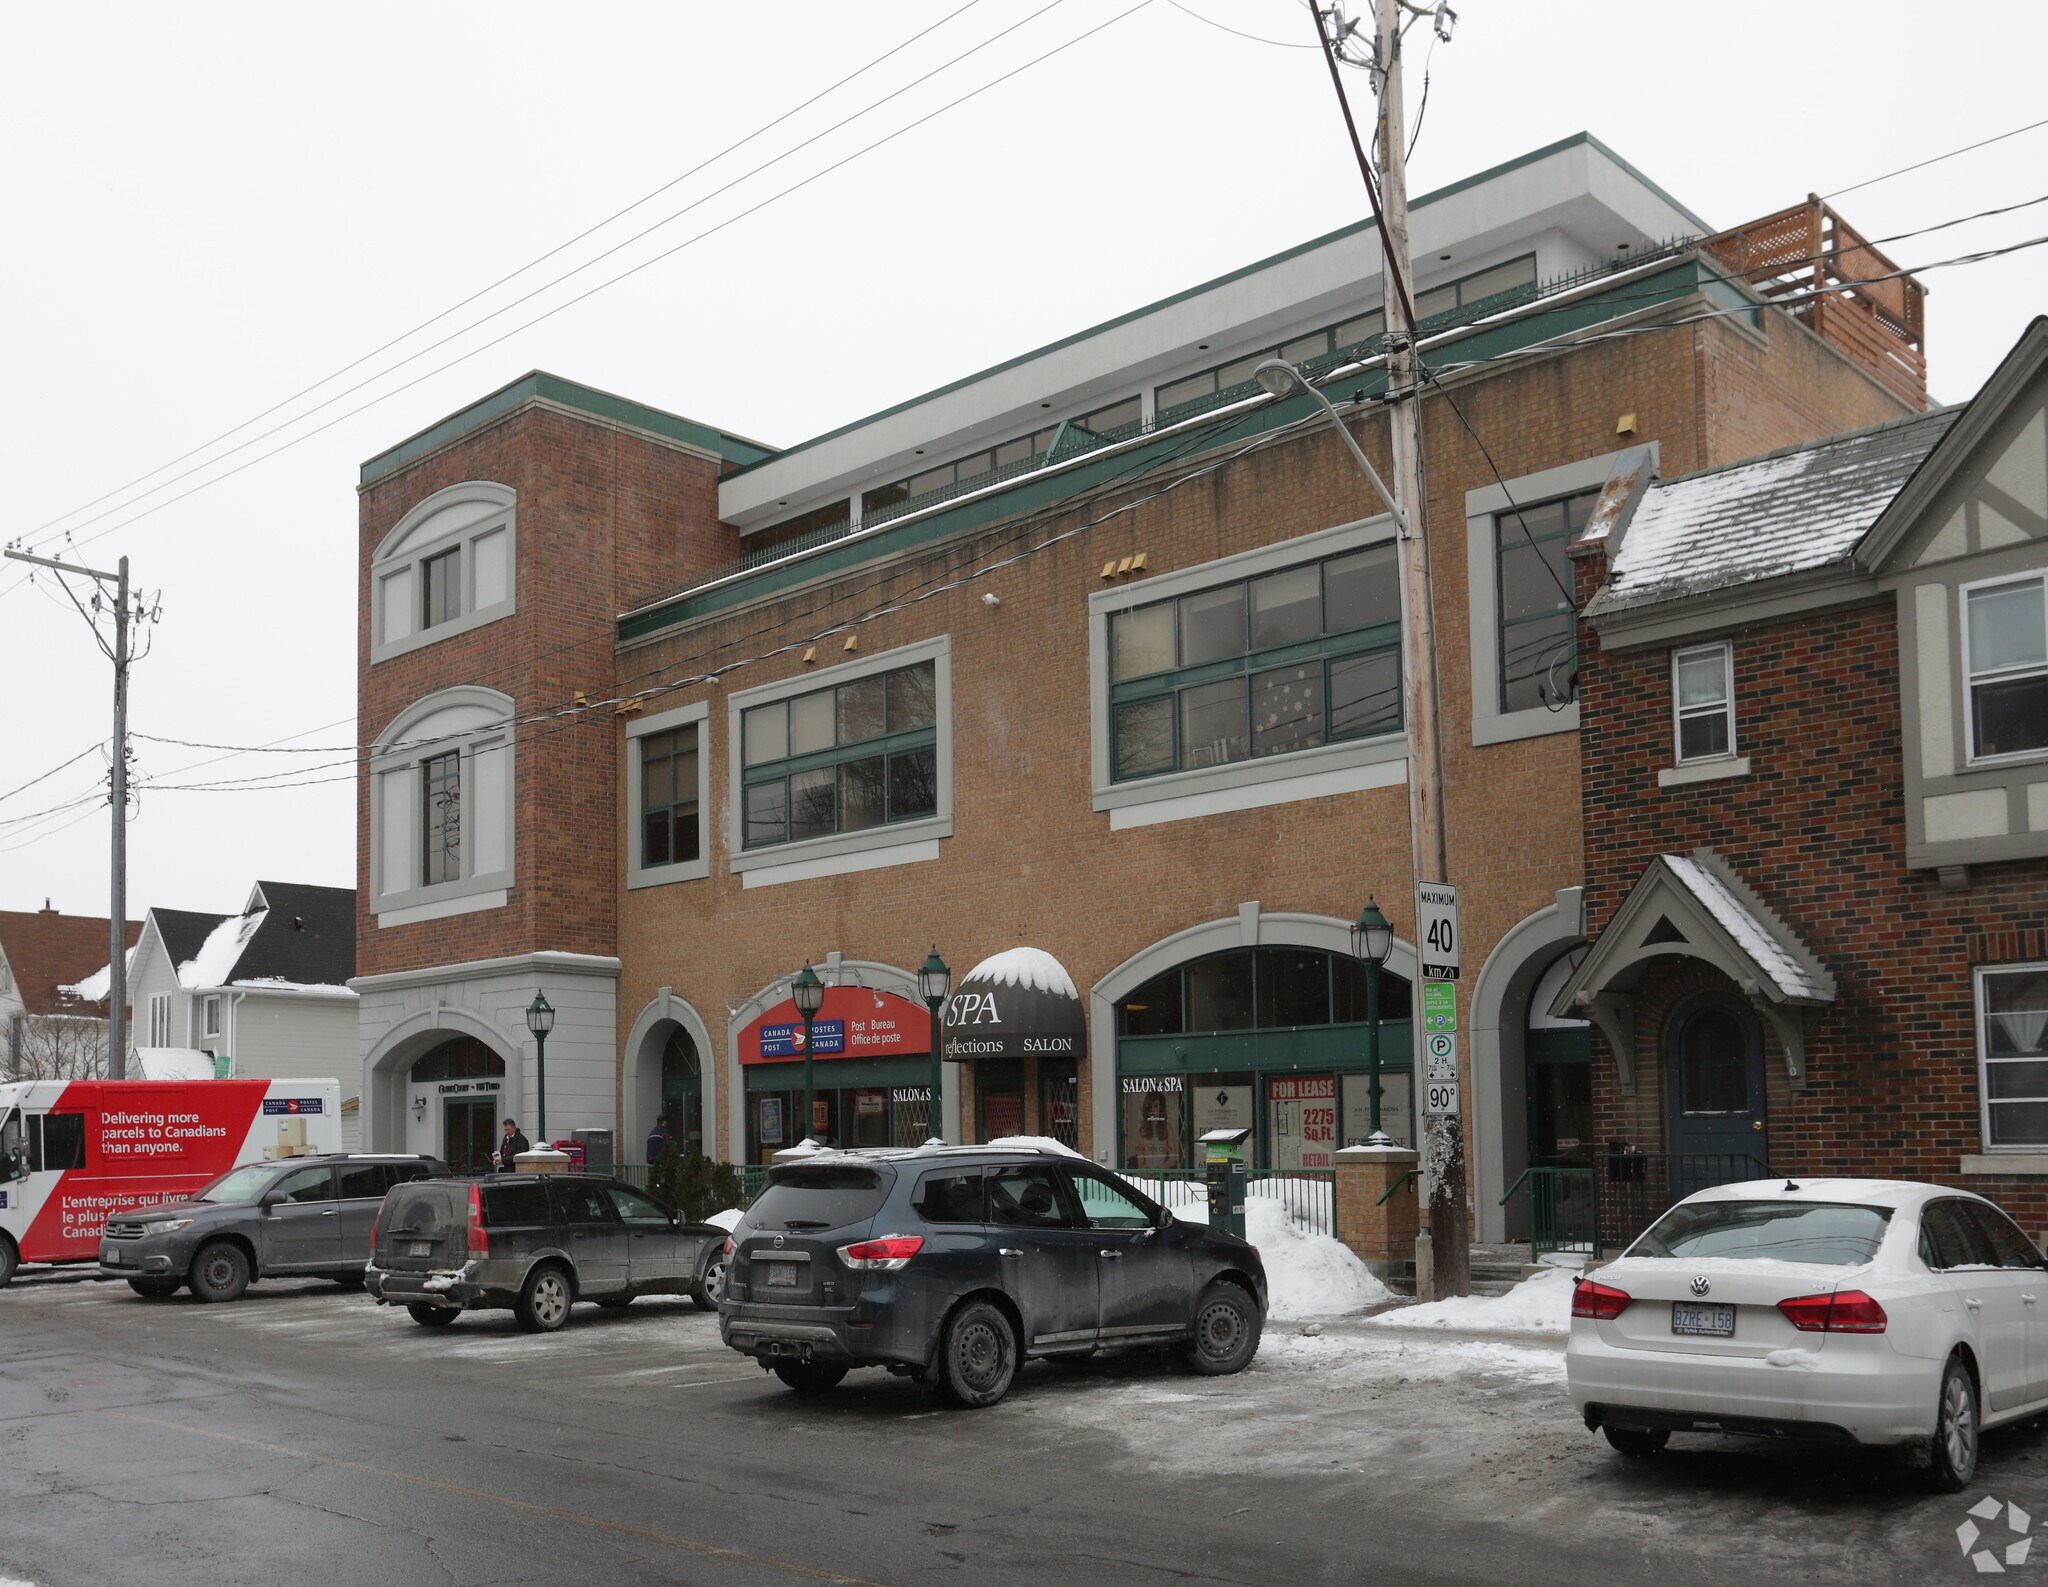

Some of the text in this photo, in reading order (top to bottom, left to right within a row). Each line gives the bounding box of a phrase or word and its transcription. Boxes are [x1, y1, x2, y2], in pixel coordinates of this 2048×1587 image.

[1421, 892, 1454, 906] MAXIMUM
[1427, 919, 1453, 953] 40
[1428, 965, 1454, 979] km/h
[946, 992, 1002, 1027] SPA
[764, 1029, 791, 1037] CANADA
[851, 1020, 896, 1032] Post Bureau
[851, 1032, 901, 1046] Office de poste
[1437, 1040, 1446, 1051] P
[764, 1044, 780, 1052] POST
[946, 1037, 1072, 1058] reflections SALON
[1122, 1077, 1183, 1093] SALON & SPA
[1272, 1080, 1334, 1098] FOR LEASE
[893, 1088, 920, 1102] SALON
[920, 1091, 925, 1101] &
[1430, 1088, 1455, 1108] 90°
[101, 1112, 199, 1126] Delivering more
[1304, 1109, 1334, 1126] 2275
[102, 1125, 226, 1142] parcels to Canadians
[1304, 1126, 1334, 1142] Sq.Ft.
[102, 1142, 183, 1155] than anyone.
[1303, 1154, 1330, 1167] RETAIL
[62, 1192, 189, 1209] L'entreprise qui livre
[62, 1211, 74, 1223] le
[78, 1210, 105, 1225] plus
[62, 1224, 106, 1238] Canadi
[1675, 1310, 1732, 1328] BZRE 158
